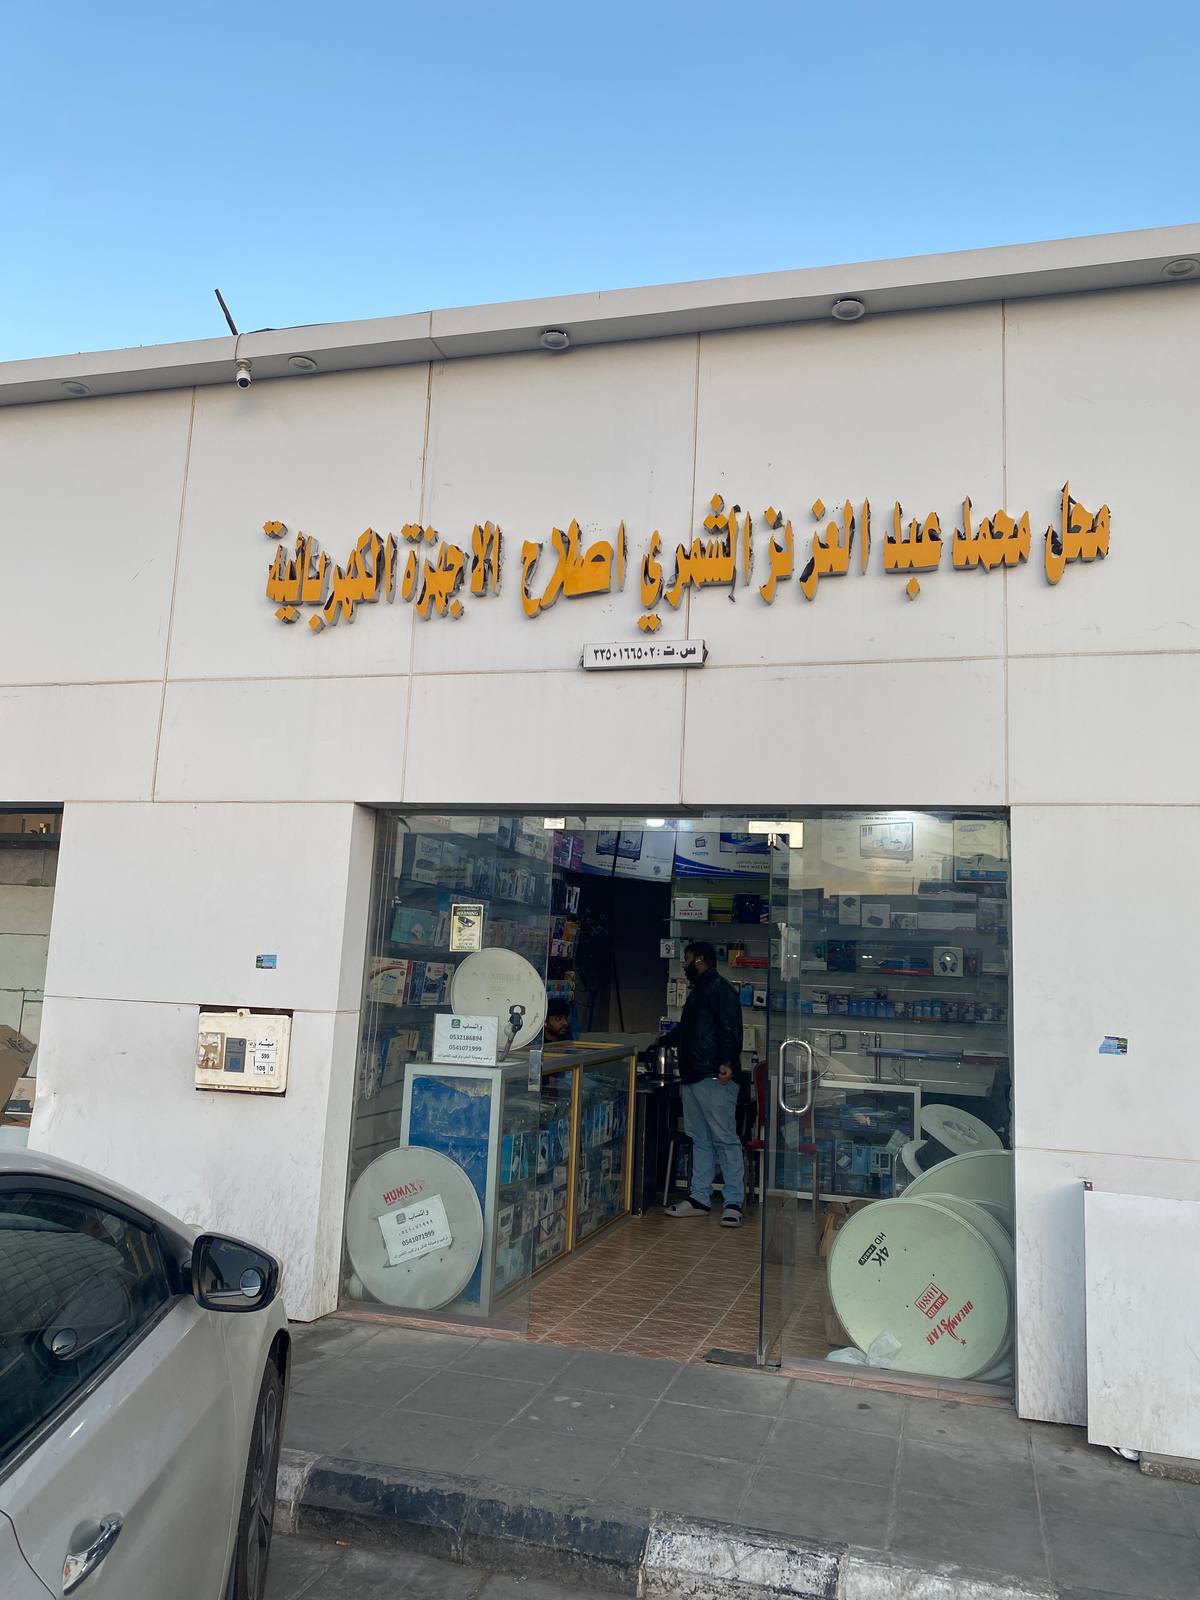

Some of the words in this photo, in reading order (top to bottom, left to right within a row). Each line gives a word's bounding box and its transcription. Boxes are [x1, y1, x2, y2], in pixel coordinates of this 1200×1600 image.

[400, 520, 502, 621] الاجهزة
[521, 517, 629, 619] اصلاح
[637, 493, 752, 634] الشمري
[884, 496, 942, 601] عبد
[952, 495, 1031, 573] محمد
[1044, 480, 1111, 585] محل
[383, 1182, 418, 1204] HUMAX
[871, 1246, 890, 1267] 4K
[874, 1231, 887, 1245] HD
[917, 1285, 939, 1310] 1080
